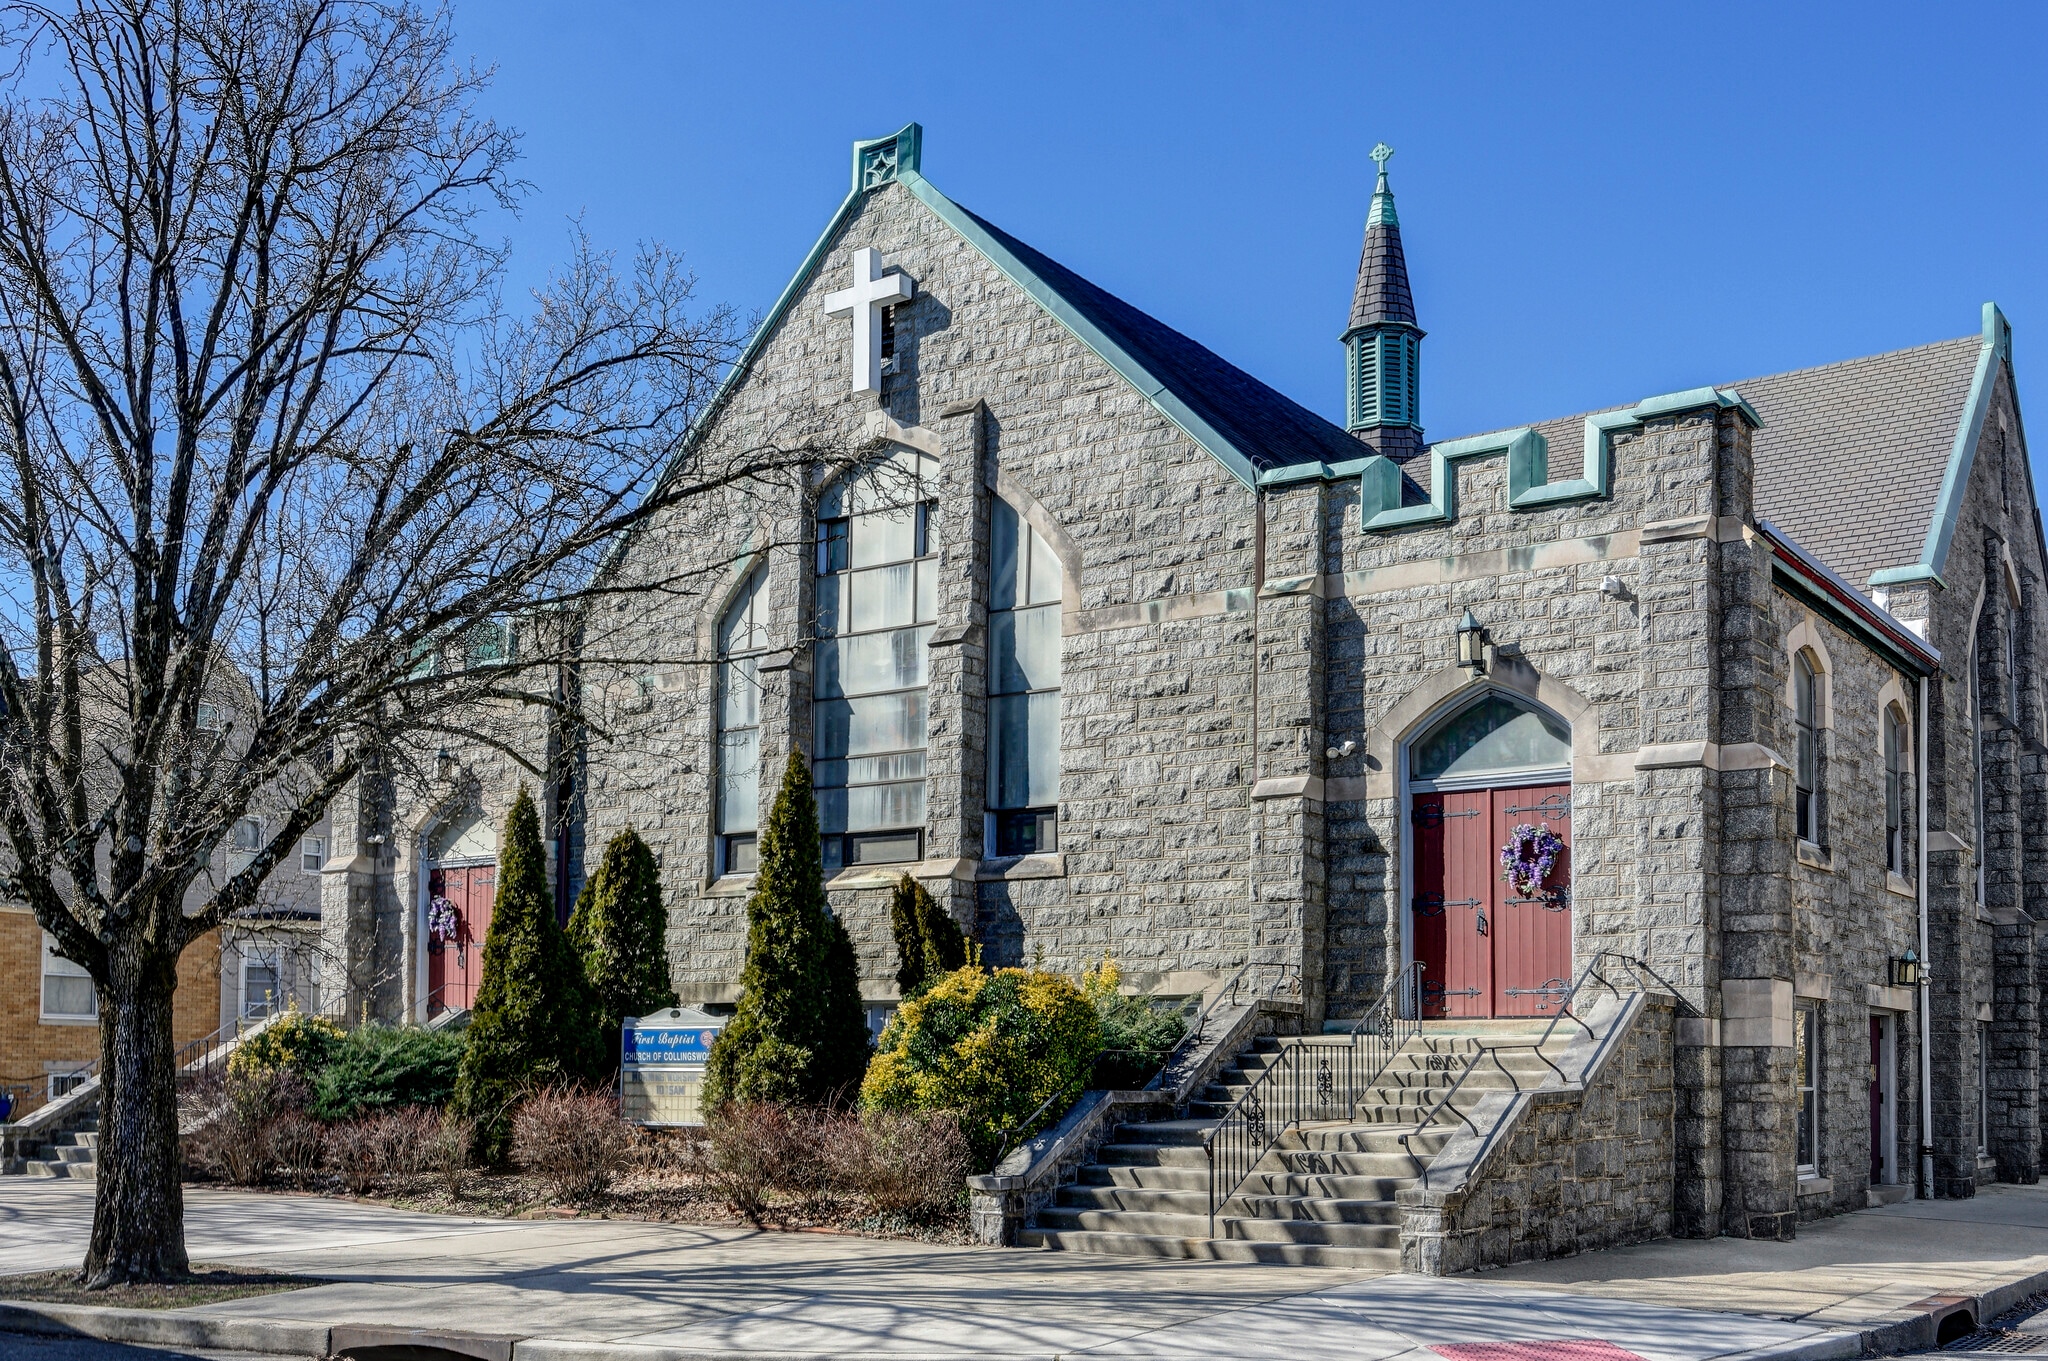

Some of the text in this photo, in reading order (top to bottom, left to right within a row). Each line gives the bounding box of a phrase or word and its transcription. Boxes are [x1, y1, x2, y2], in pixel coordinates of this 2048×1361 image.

[632, 1032, 695, 1048] First Baptist
[624, 1052, 651, 1061] CHURCH
[653, 1052, 662, 1061] OF
